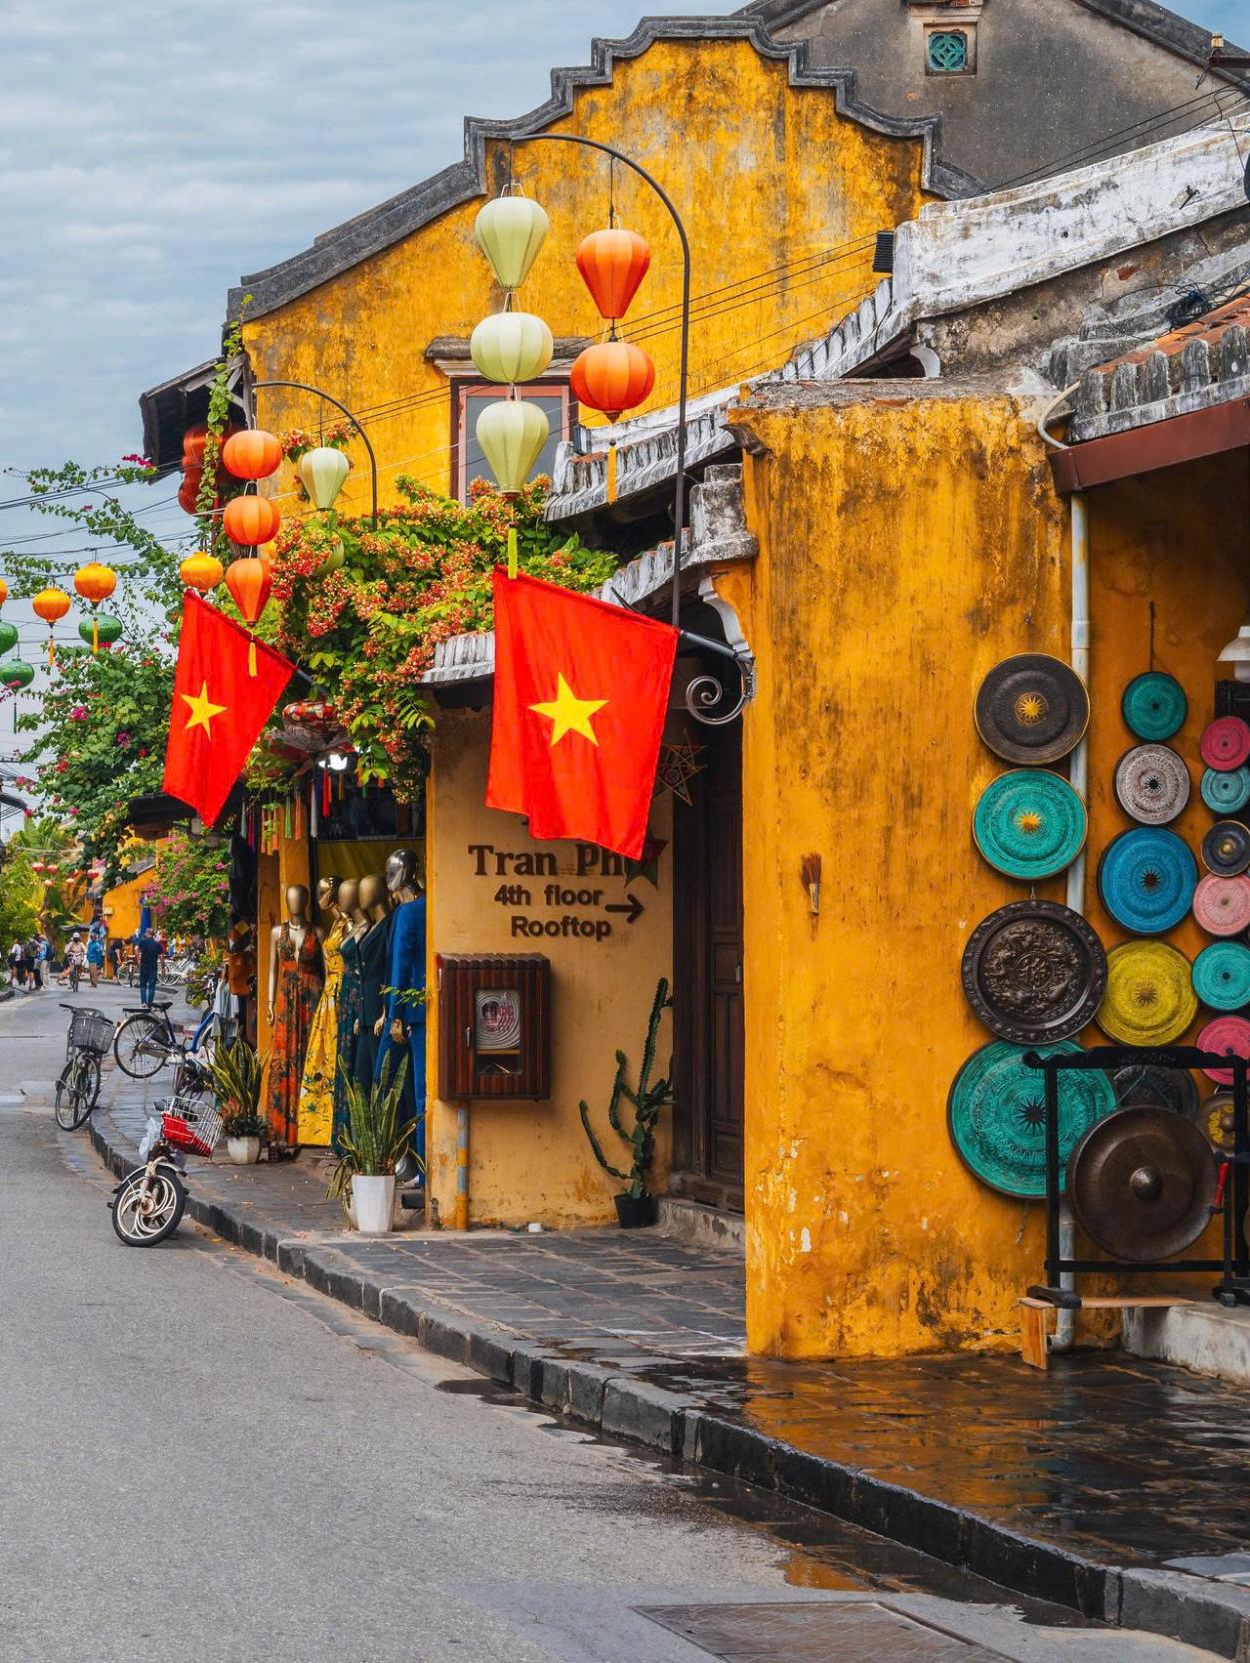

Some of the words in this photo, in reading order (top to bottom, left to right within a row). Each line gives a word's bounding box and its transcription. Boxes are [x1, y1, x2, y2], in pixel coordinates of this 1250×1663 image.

[468, 845, 558, 876] Tran
[575, 843, 623, 876] Ph
[494, 884, 532, 906] 4th
[544, 884, 604, 906] floor
[511, 915, 612, 942] Rooftop
